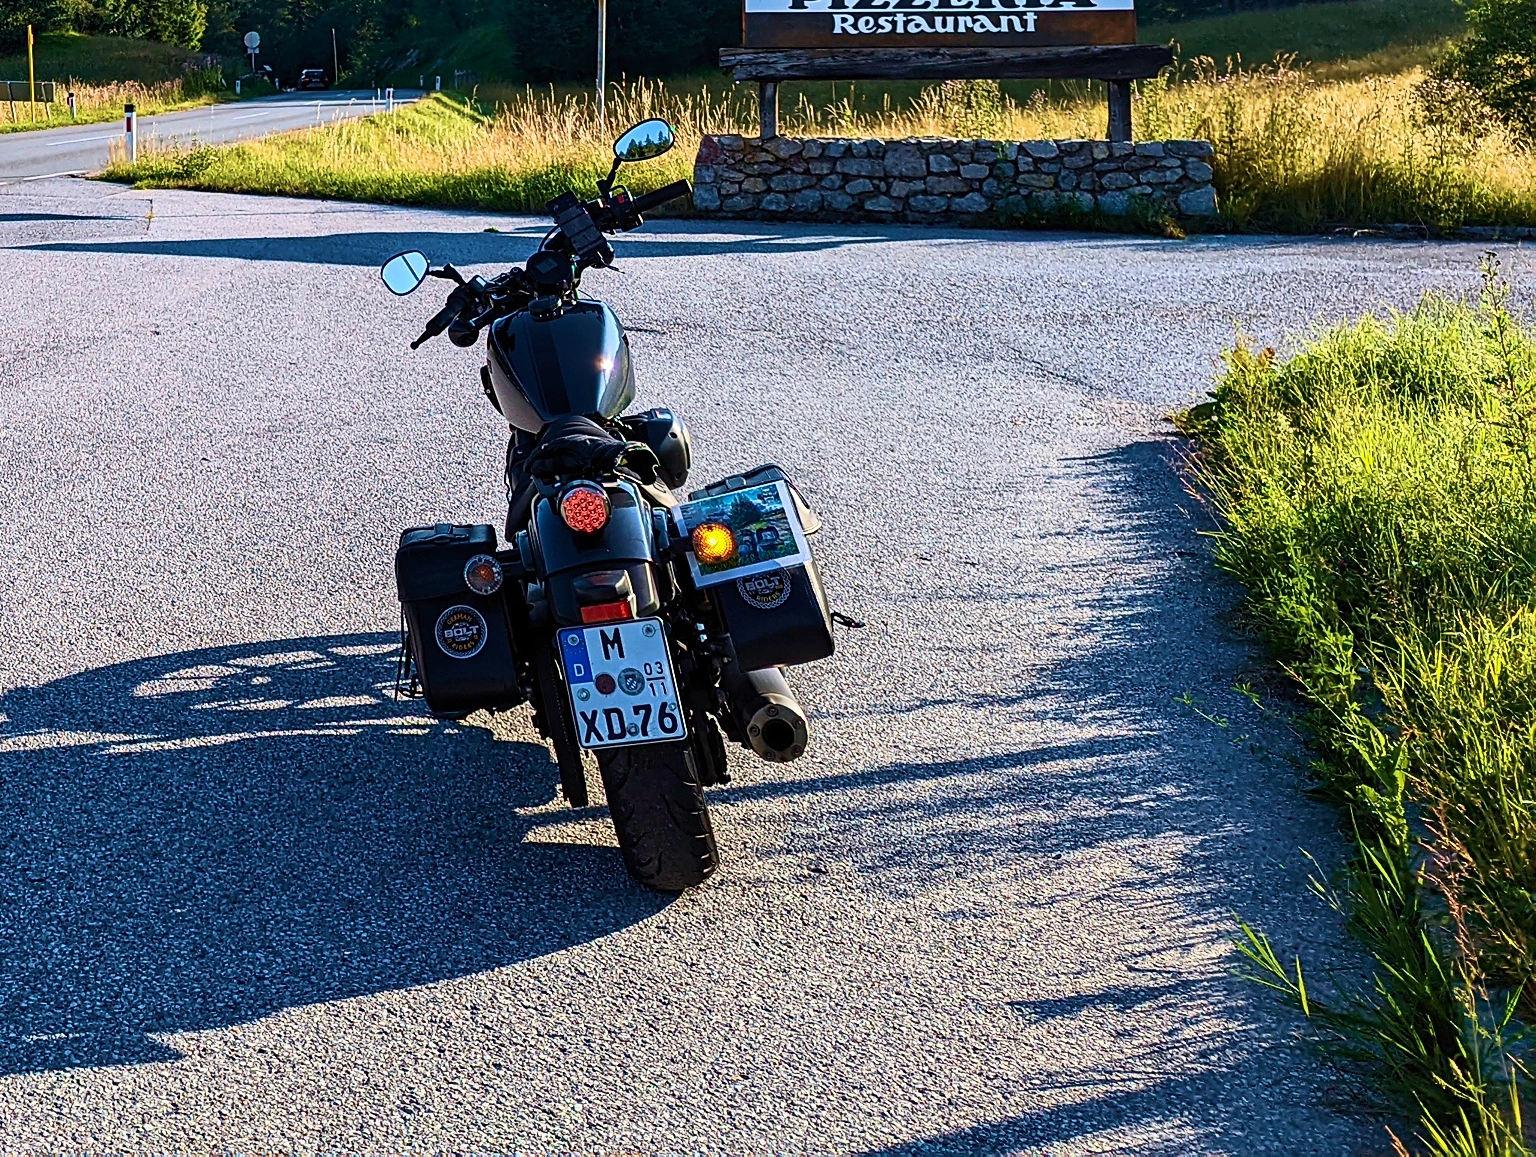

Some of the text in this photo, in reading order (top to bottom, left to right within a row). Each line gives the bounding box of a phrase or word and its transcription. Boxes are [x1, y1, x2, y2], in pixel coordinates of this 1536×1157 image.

[832, 11, 1038, 35] Restaurant
[745, 576, 780, 591] BOLT
[444, 625, 479, 638] BOLT
[599, 627, 625, 660] M
[573, 663, 585, 677] D
[643, 661, 664, 676] 03
[648, 682, 667, 697] 11
